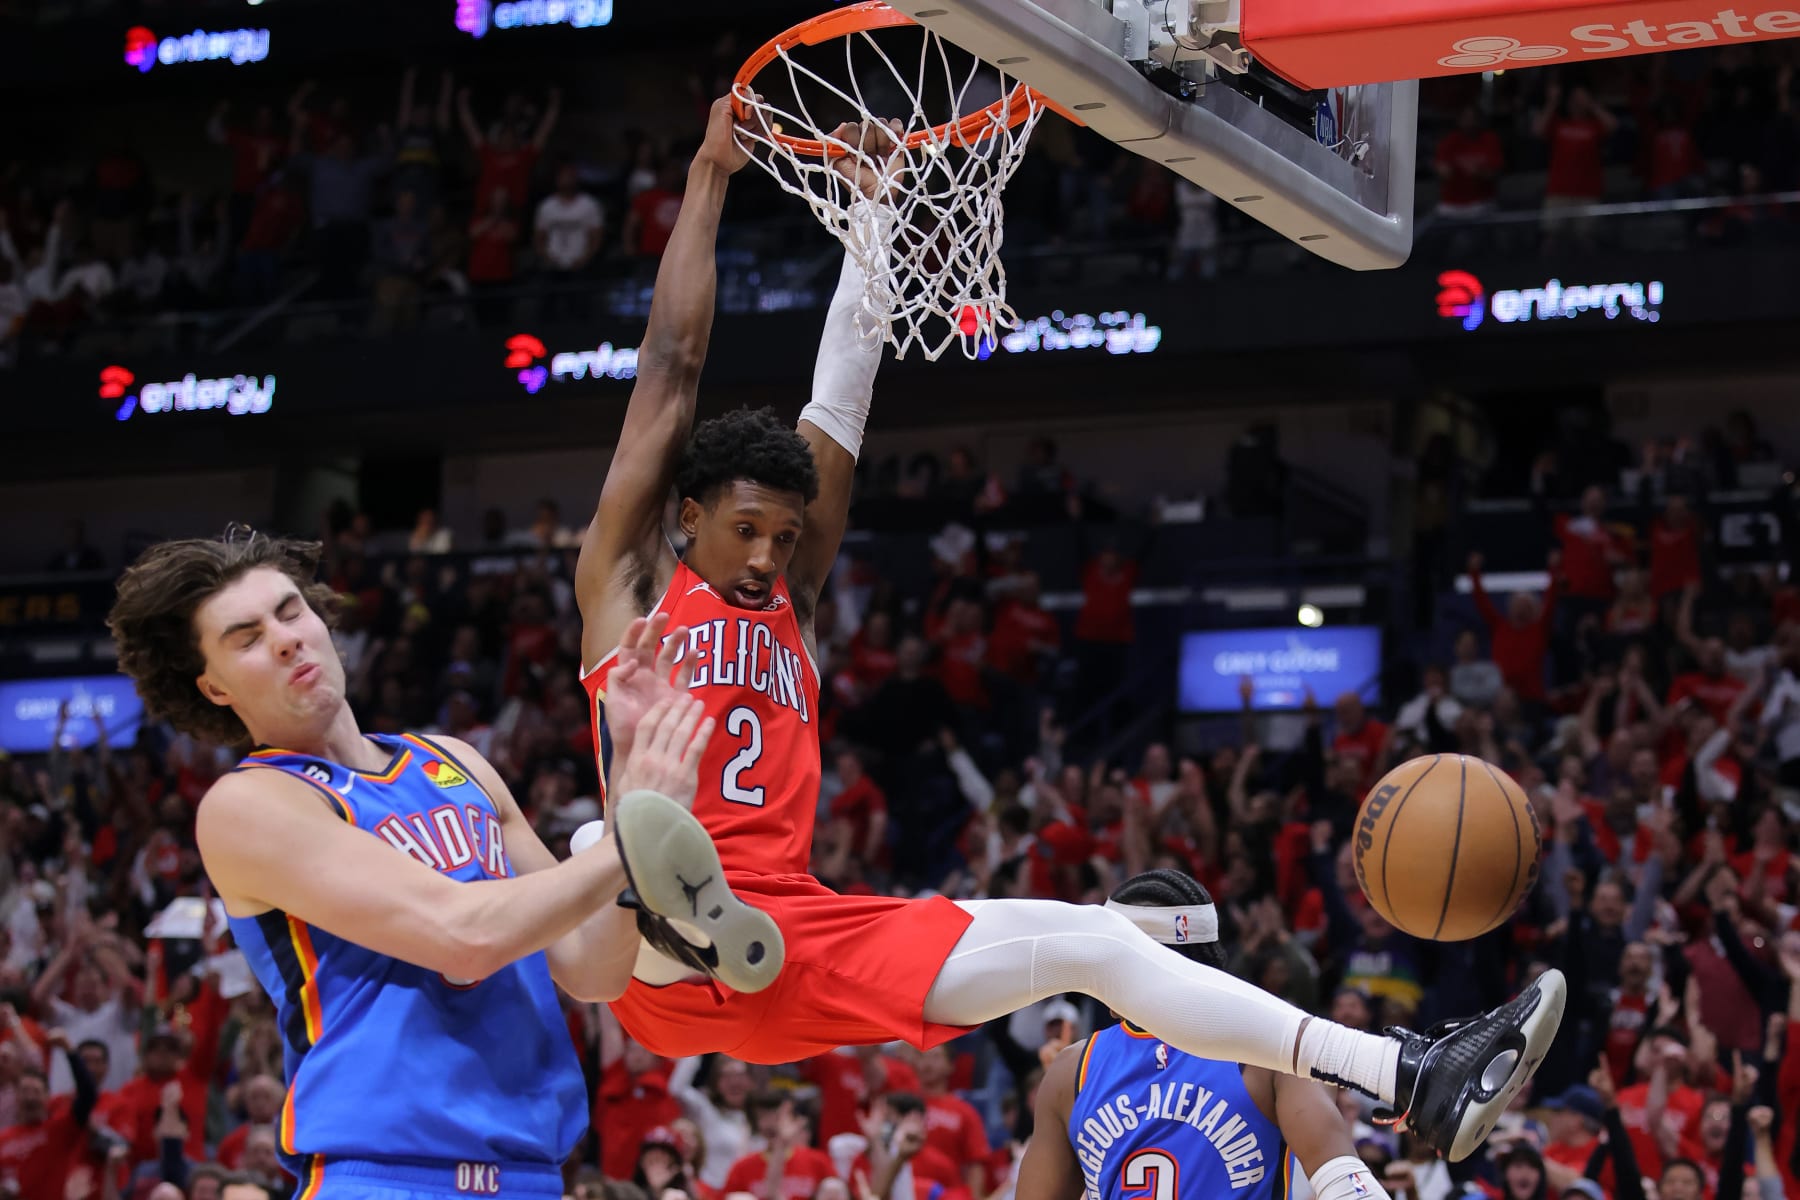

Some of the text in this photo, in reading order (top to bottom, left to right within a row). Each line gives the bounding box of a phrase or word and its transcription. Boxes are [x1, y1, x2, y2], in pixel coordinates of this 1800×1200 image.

[1570, 9, 1800, 53] State
[721, 704, 765, 807] 2
[456, 1161, 500, 1194] OKC
